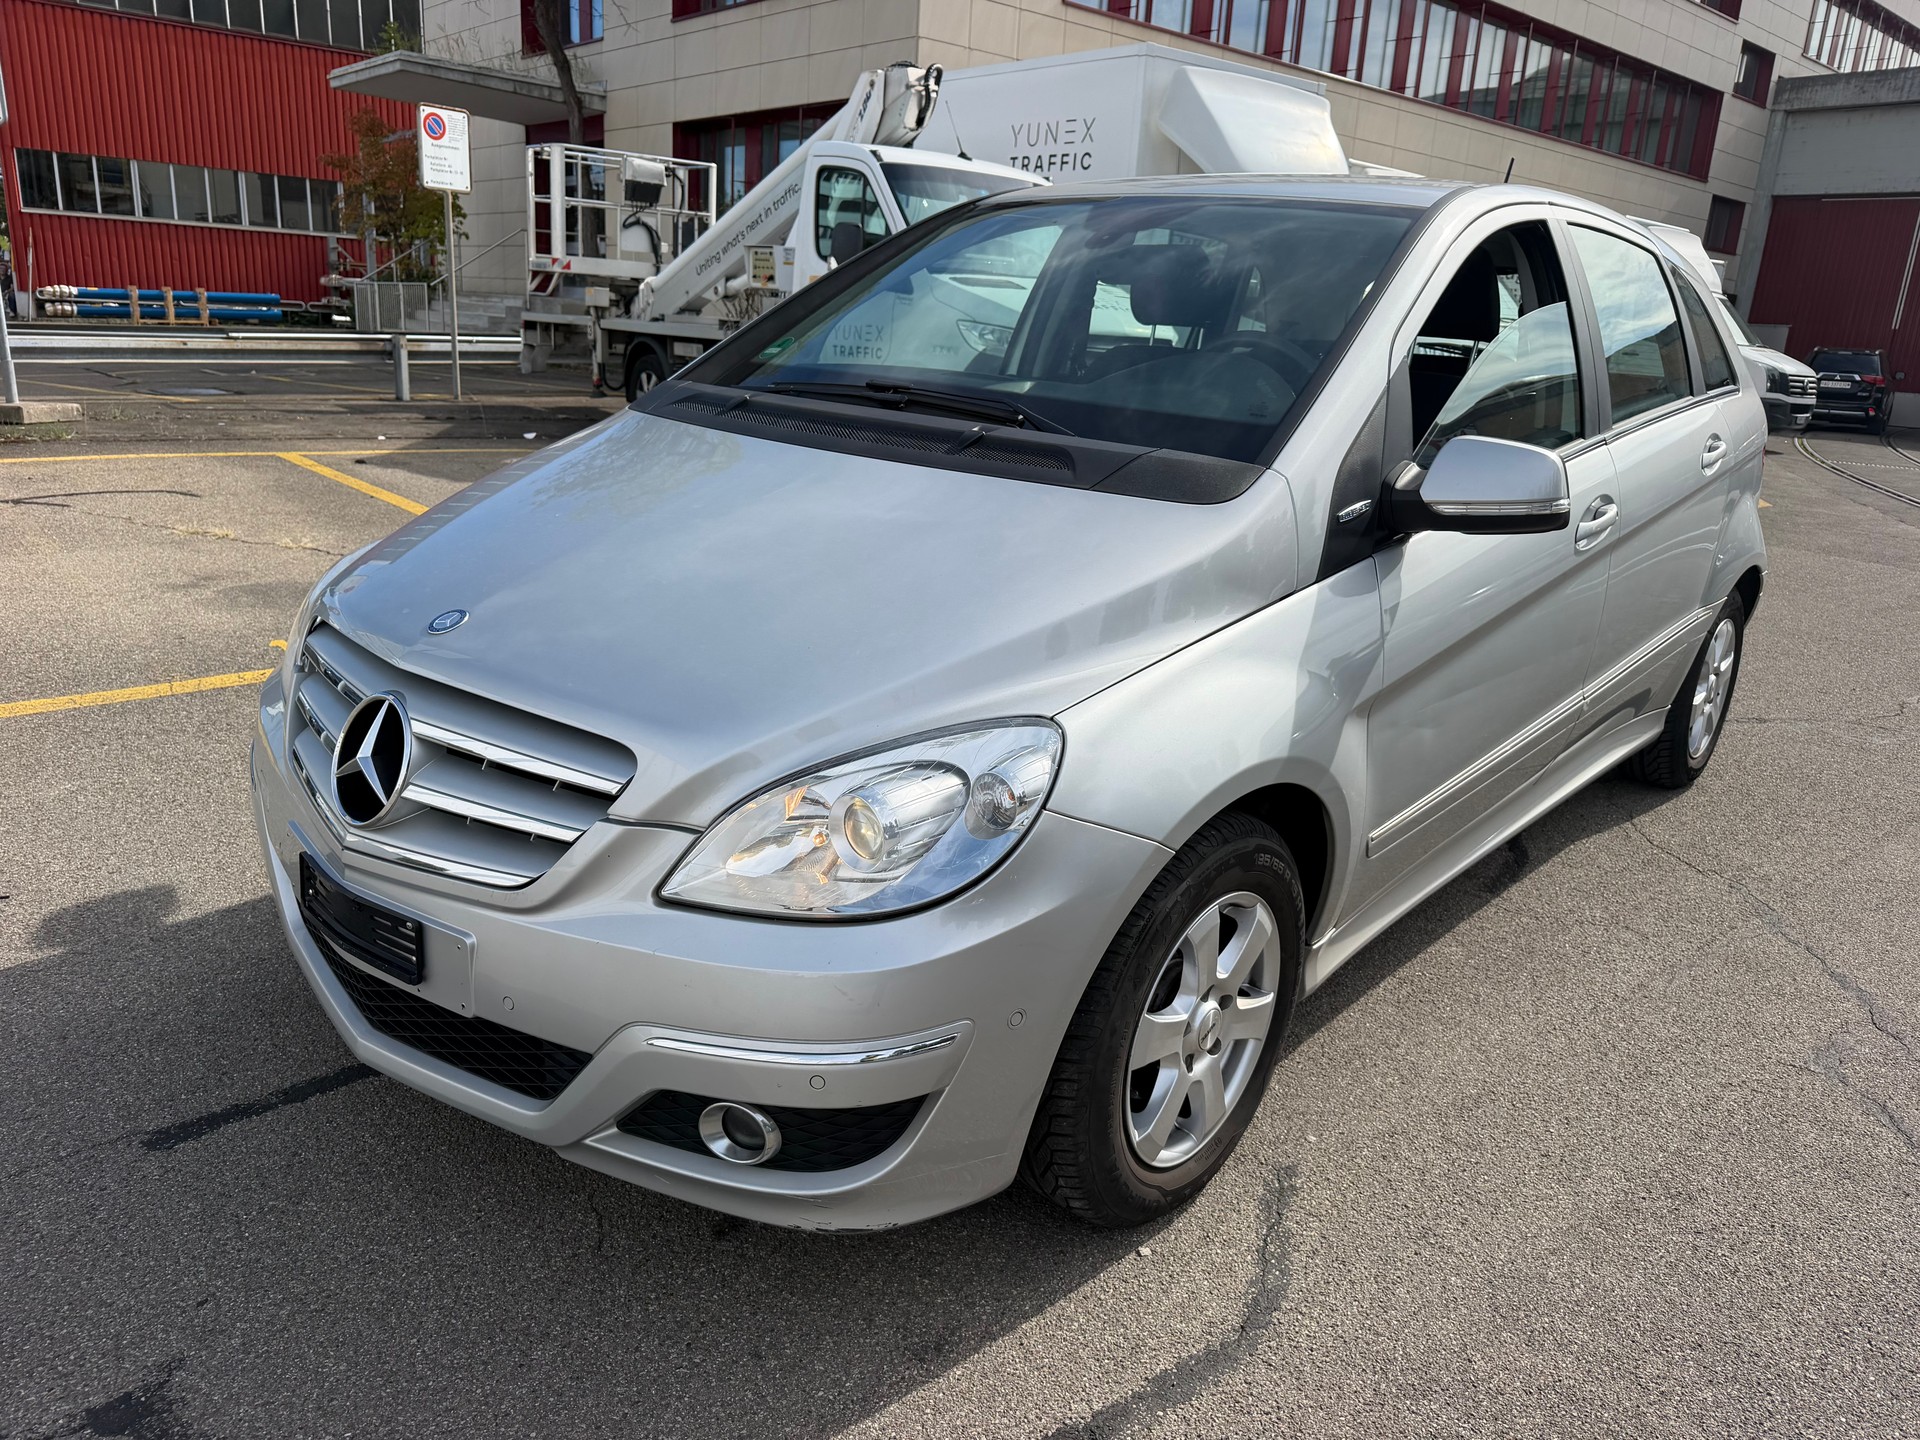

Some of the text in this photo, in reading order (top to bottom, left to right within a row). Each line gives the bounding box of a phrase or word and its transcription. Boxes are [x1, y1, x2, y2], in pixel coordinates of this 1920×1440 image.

[1010, 117, 1096, 148] YUNEX
[1009, 151, 1092, 174] TRAFFIC
[695, 251, 722, 276] Uniting
[721, 230, 746, 256] what's
[745, 213, 764, 236] next
[763, 205, 773, 219] in
[772, 183, 802, 211] traffic.
[834, 324, 885, 343] YUNEX
[832, 344, 883, 360] TRAFFIC
[1253, 852, 1285, 875] 195/65
